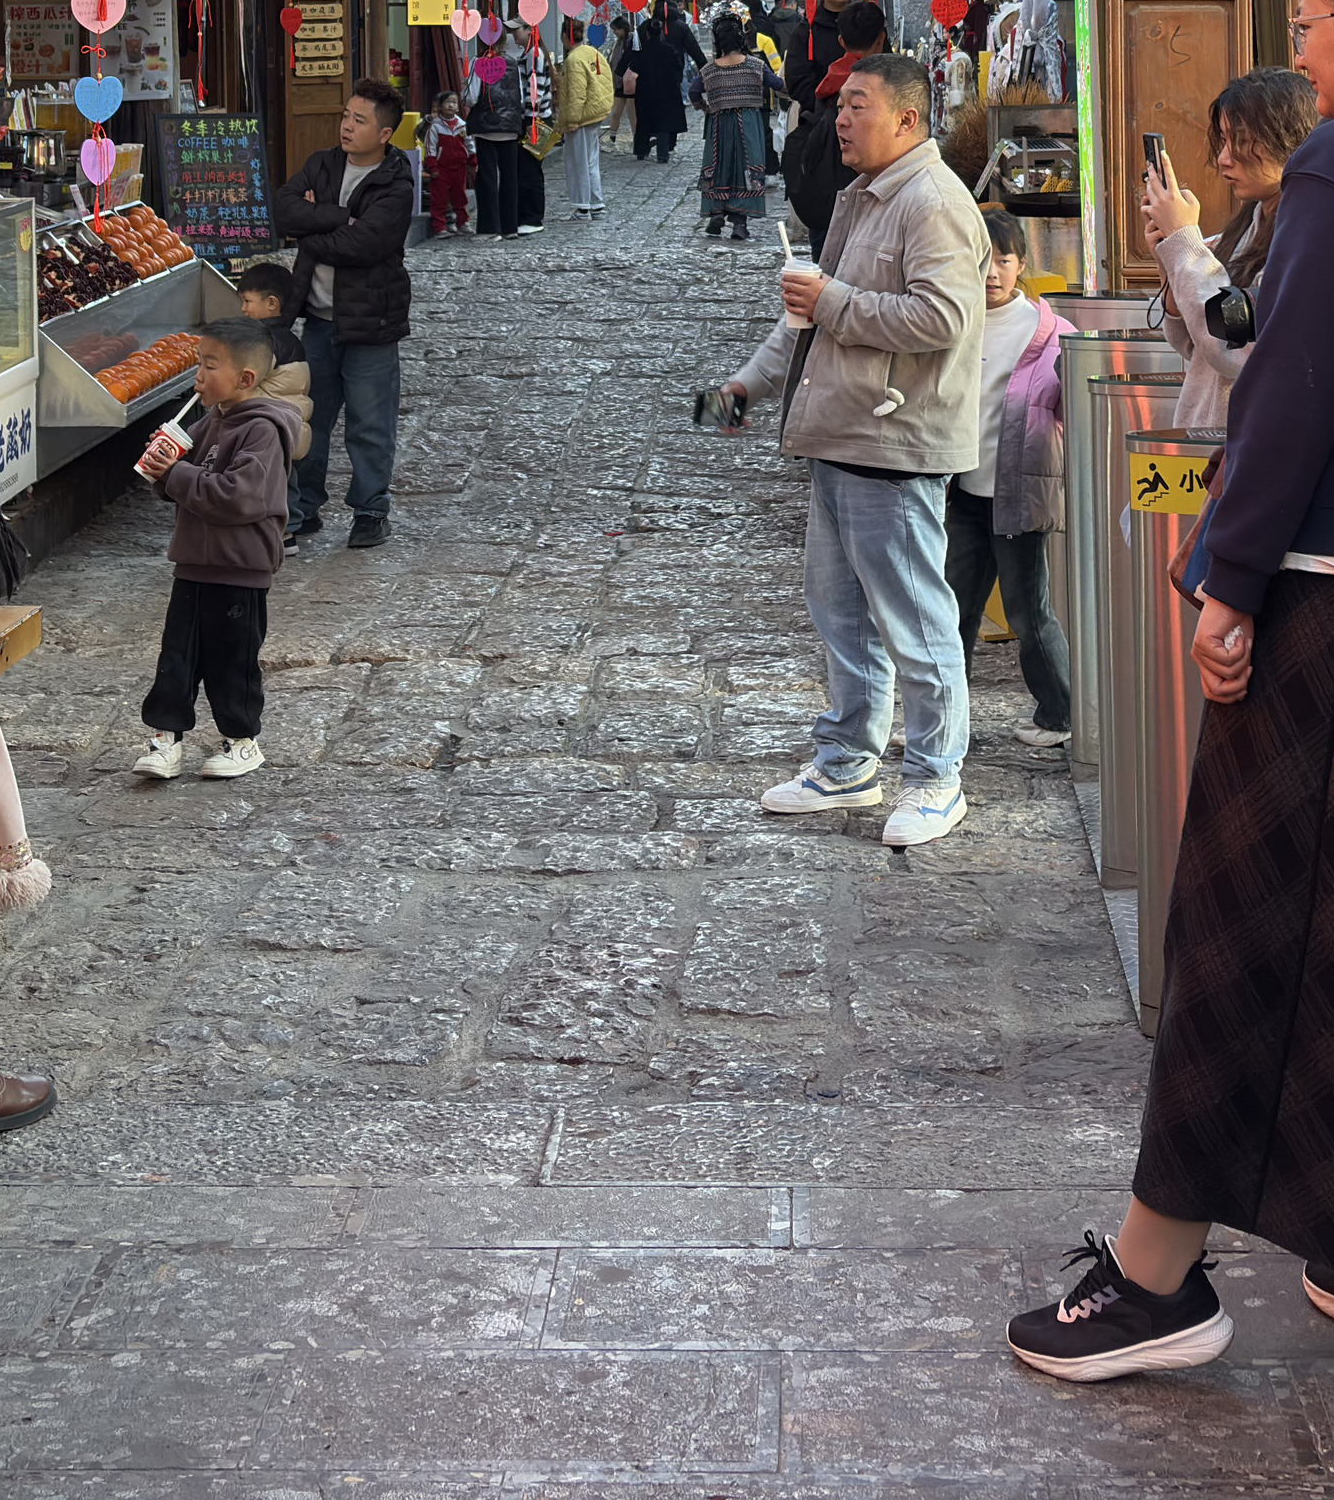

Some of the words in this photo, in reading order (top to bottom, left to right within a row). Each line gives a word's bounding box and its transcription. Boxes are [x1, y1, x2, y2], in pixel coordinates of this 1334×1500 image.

[181, 119, 260, 137] 冬季冷热饮
[177, 136, 218, 150] COFFEE
[221, 135, 250, 149] 咖啡
[181, 150, 234, 165] 鲜榨果汁
